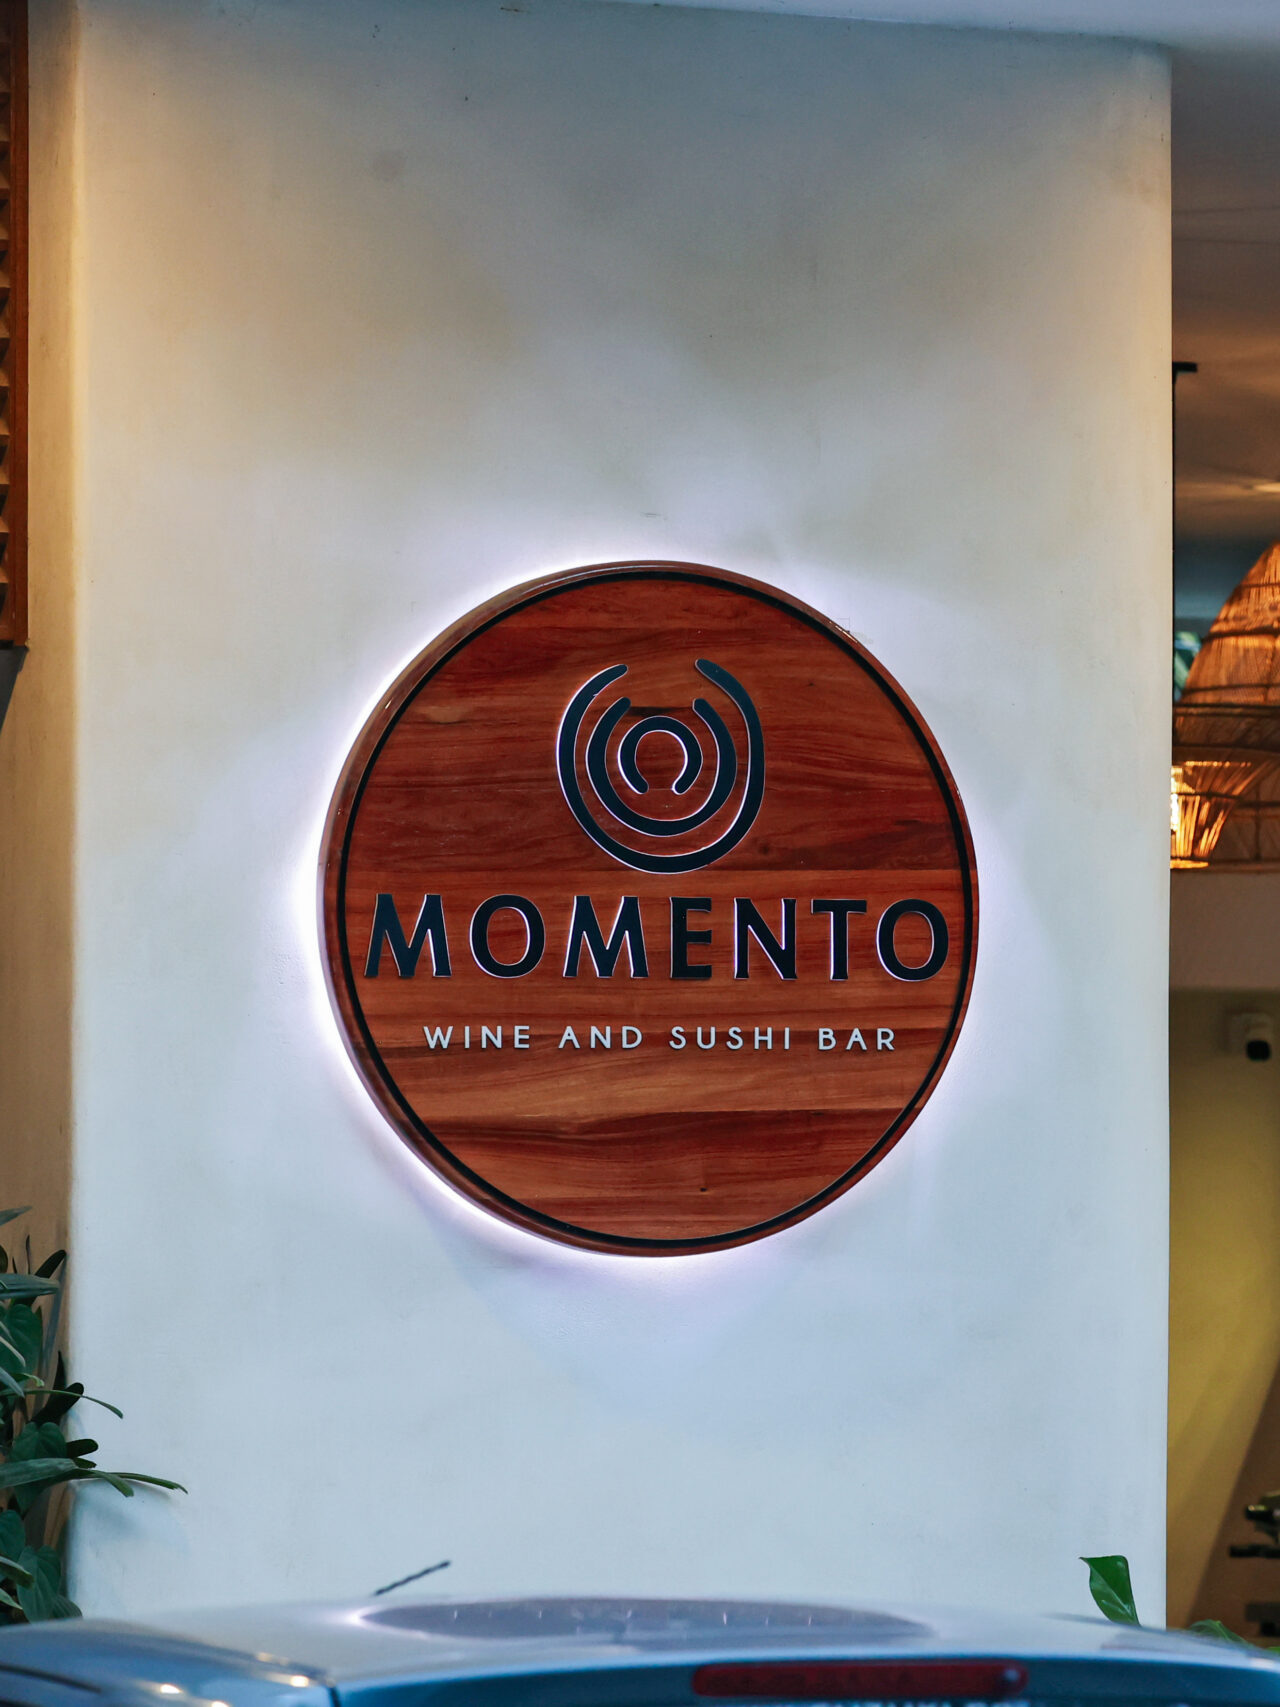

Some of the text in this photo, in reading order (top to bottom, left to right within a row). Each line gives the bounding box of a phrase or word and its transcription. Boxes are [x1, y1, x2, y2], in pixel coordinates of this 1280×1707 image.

[364, 893, 950, 982] MOMENTO
[422, 1024, 896, 1052] WINE AND SUSHI BAR
